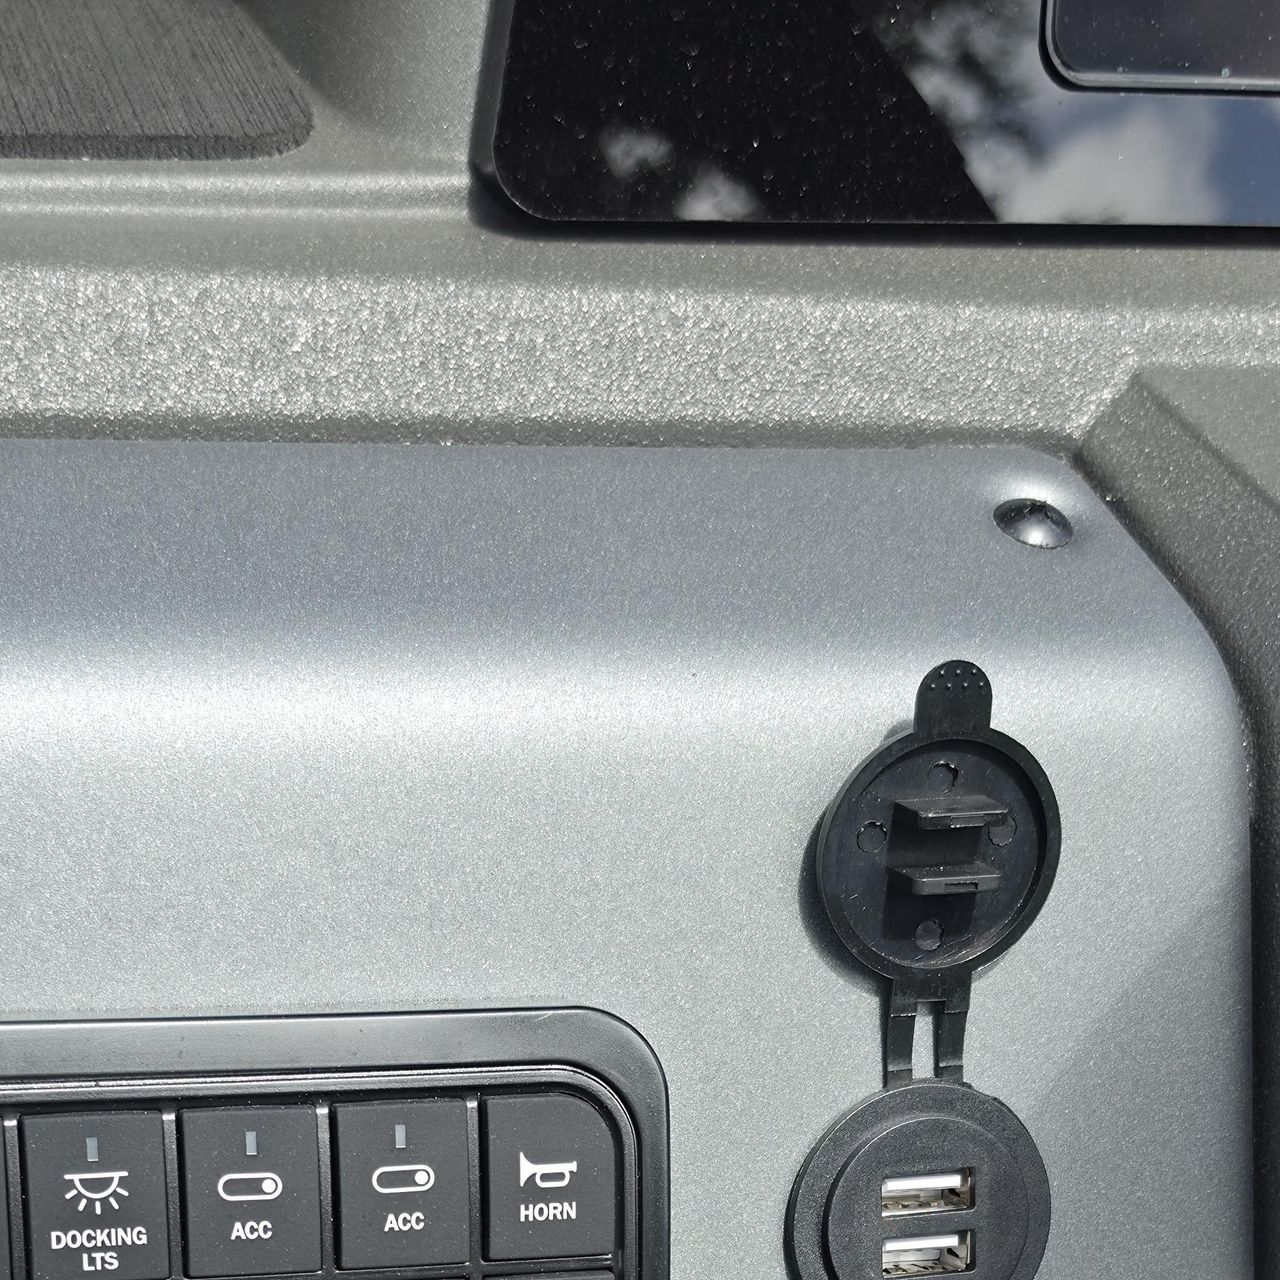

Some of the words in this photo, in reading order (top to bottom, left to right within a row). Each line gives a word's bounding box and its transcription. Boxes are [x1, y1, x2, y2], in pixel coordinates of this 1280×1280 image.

[383, 1210, 425, 1233] ACC
[519, 1200, 577, 1223] HORN
[50, 1225, 148, 1250] DOCKING
[230, 1219, 273, 1241] ACC
[81, 1251, 120, 1272] LTS
